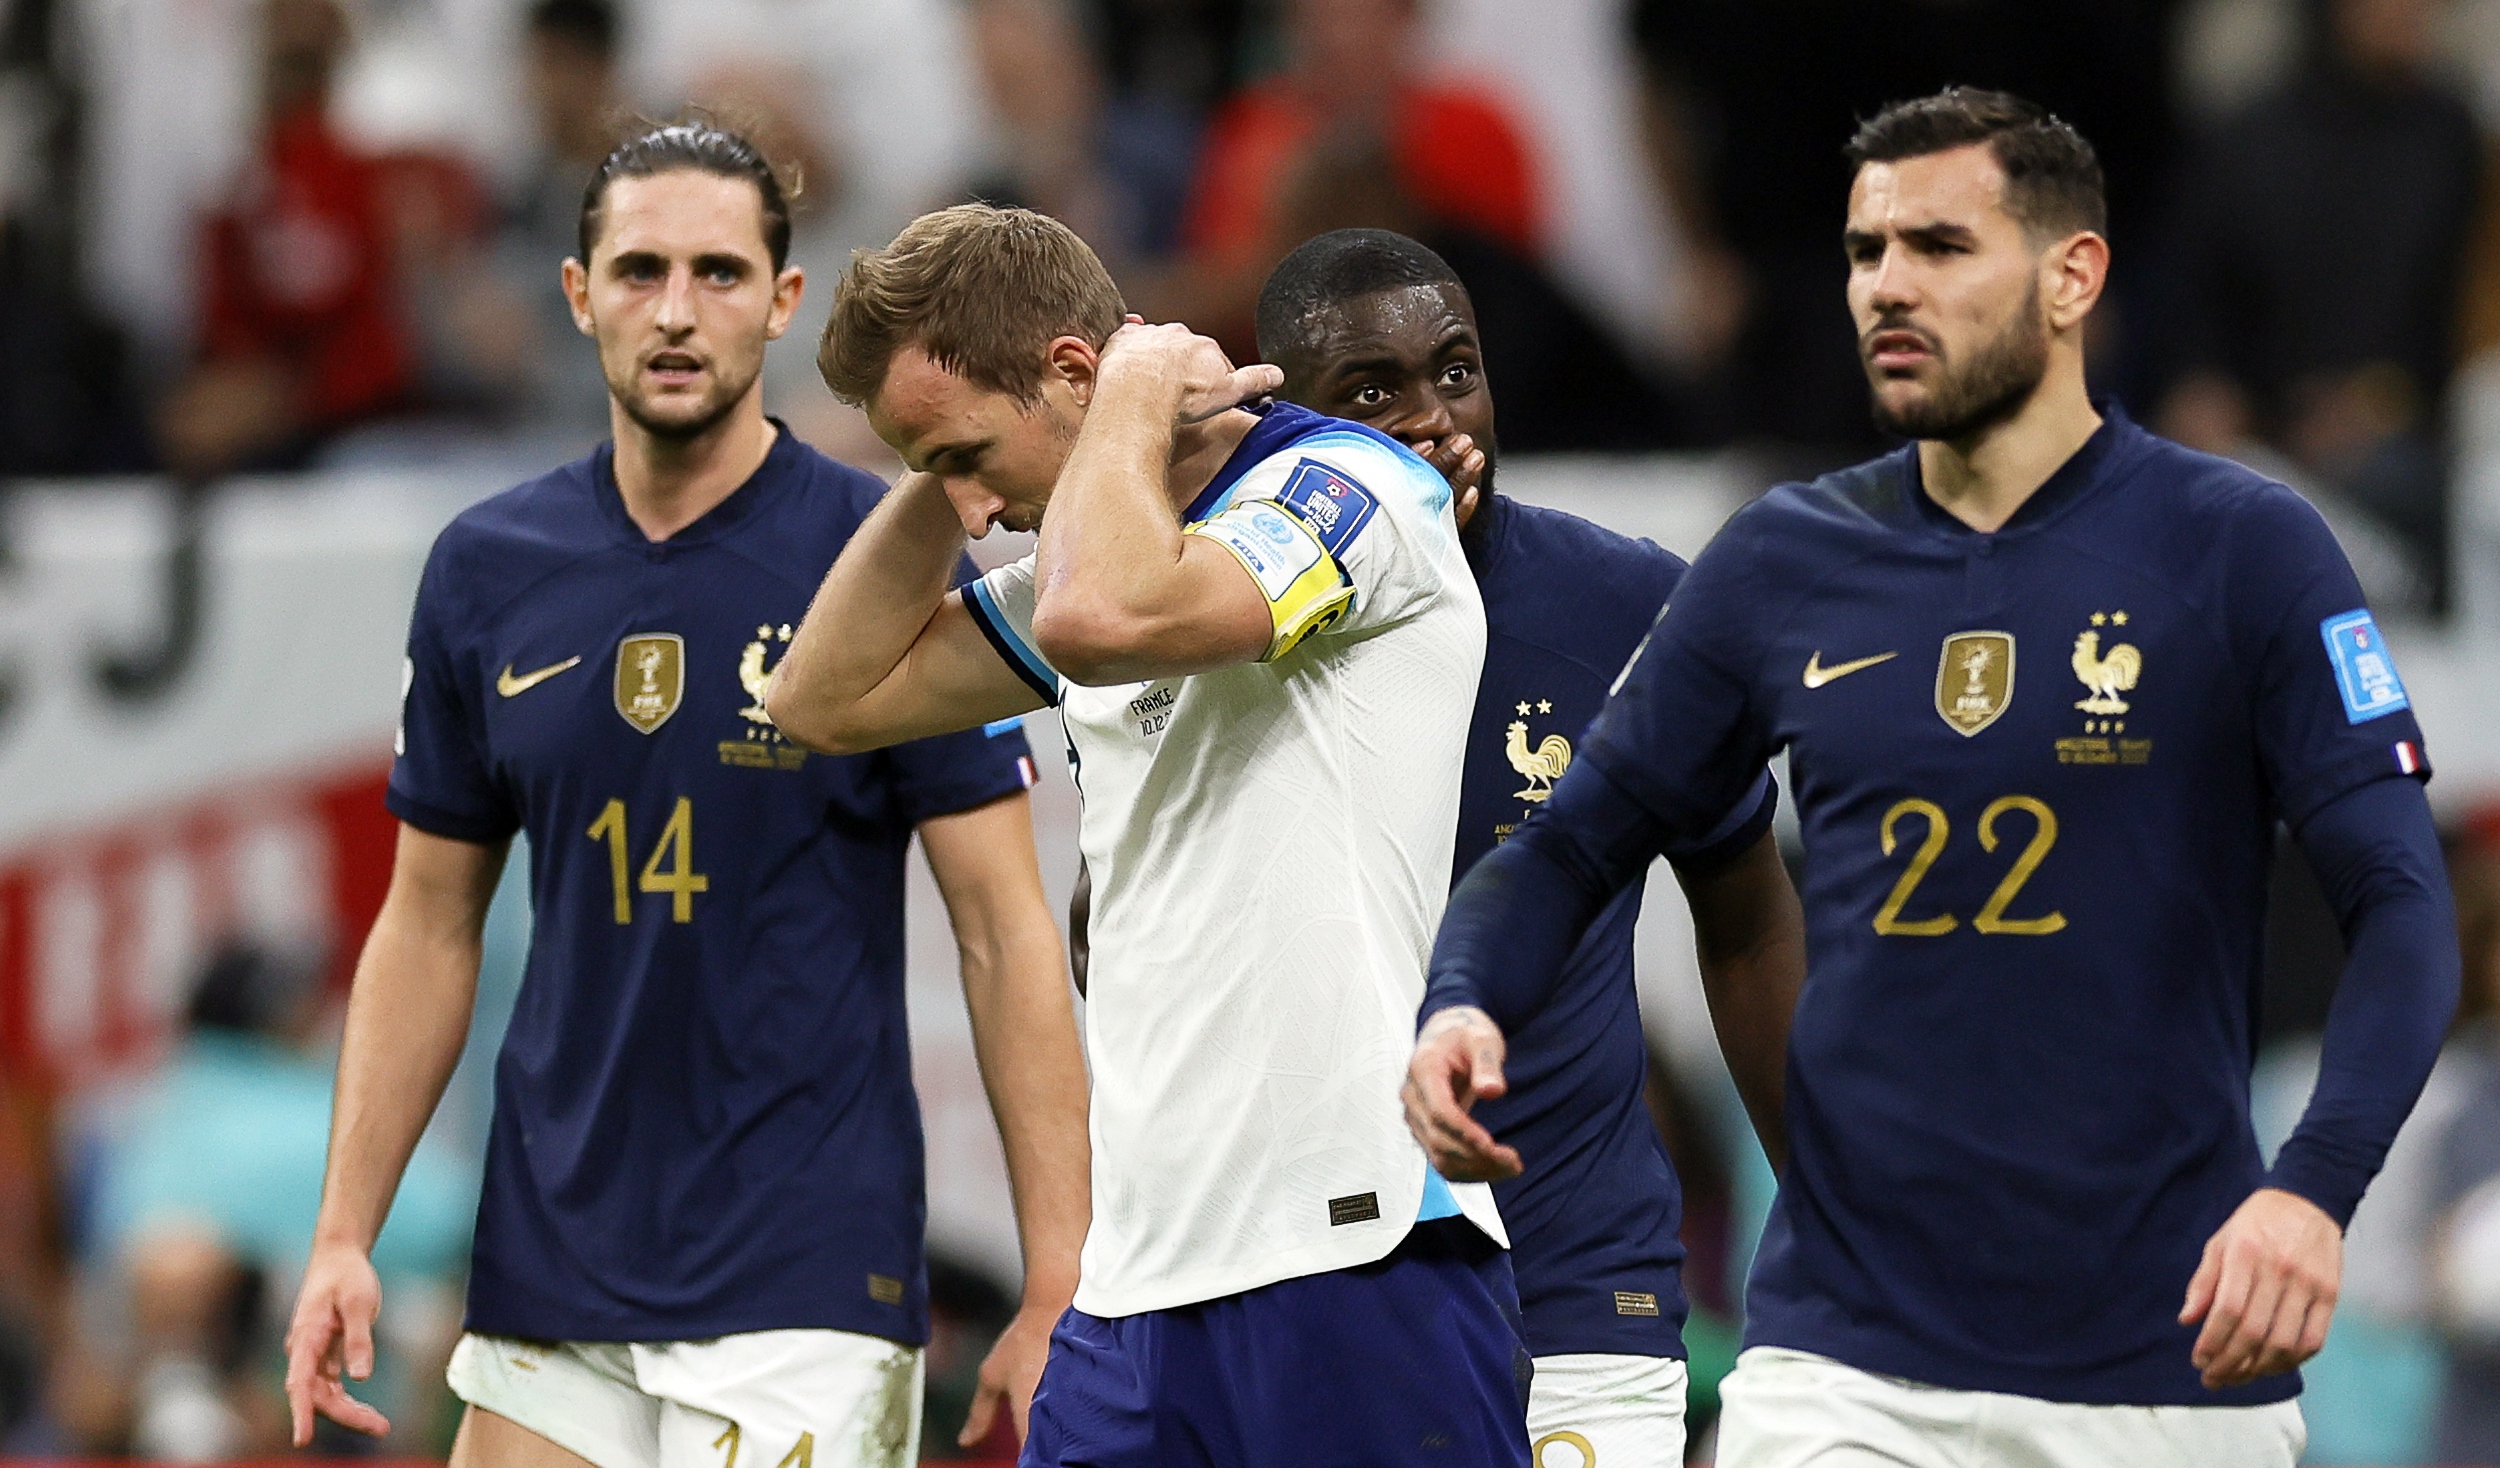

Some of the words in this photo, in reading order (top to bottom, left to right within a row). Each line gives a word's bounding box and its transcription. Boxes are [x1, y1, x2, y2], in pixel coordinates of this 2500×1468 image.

[1306, 495, 1339, 525] UNITES
[1310, 489, 1342, 517] FOOTBALL
[1130, 687, 1175, 717] FRANCE
[1140, 709, 1173, 738] 10.12
[585, 795, 709, 926] 14
[1872, 794, 2068, 936] 22
